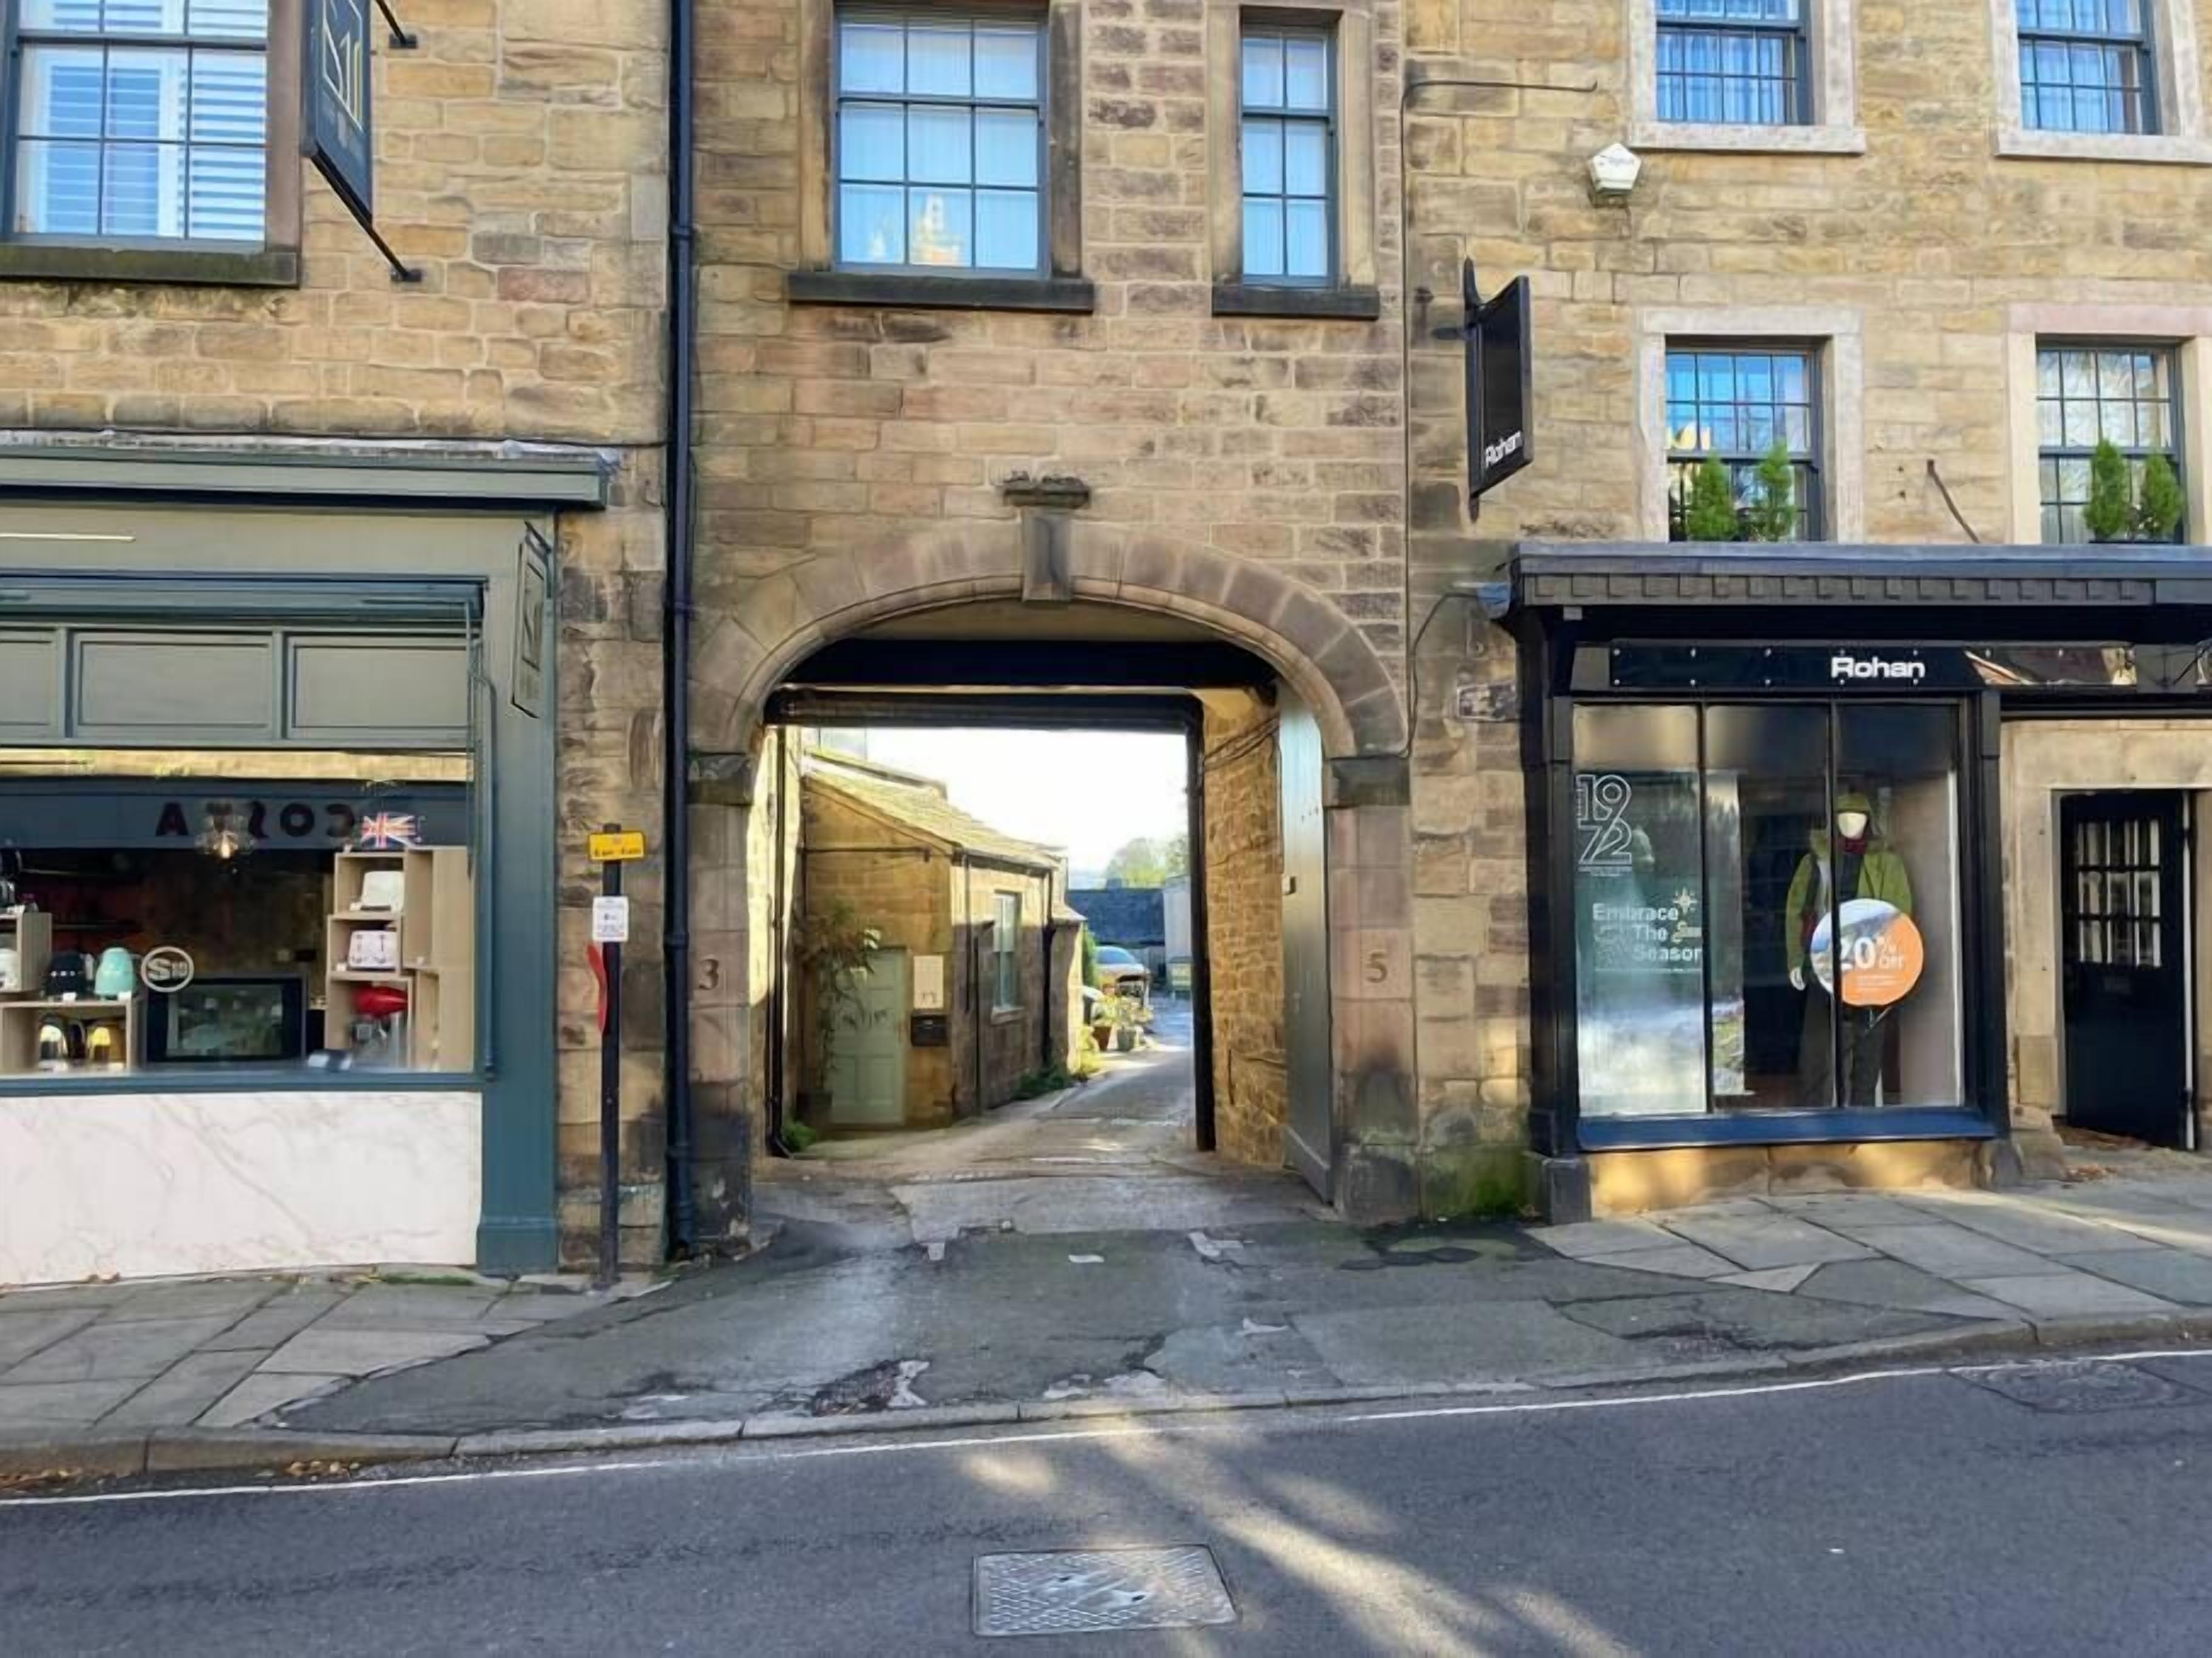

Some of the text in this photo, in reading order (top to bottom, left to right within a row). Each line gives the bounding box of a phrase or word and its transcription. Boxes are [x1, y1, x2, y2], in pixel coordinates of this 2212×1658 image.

[1485, 430, 1521, 469] Rohan
[1831, 656, 1926, 678] Rohan
[1593, 902, 1679, 921] Embrace
[1632, 923, 1668, 942] The
[699, 958, 720, 991] 3
[1365, 950, 1388, 984] 5
